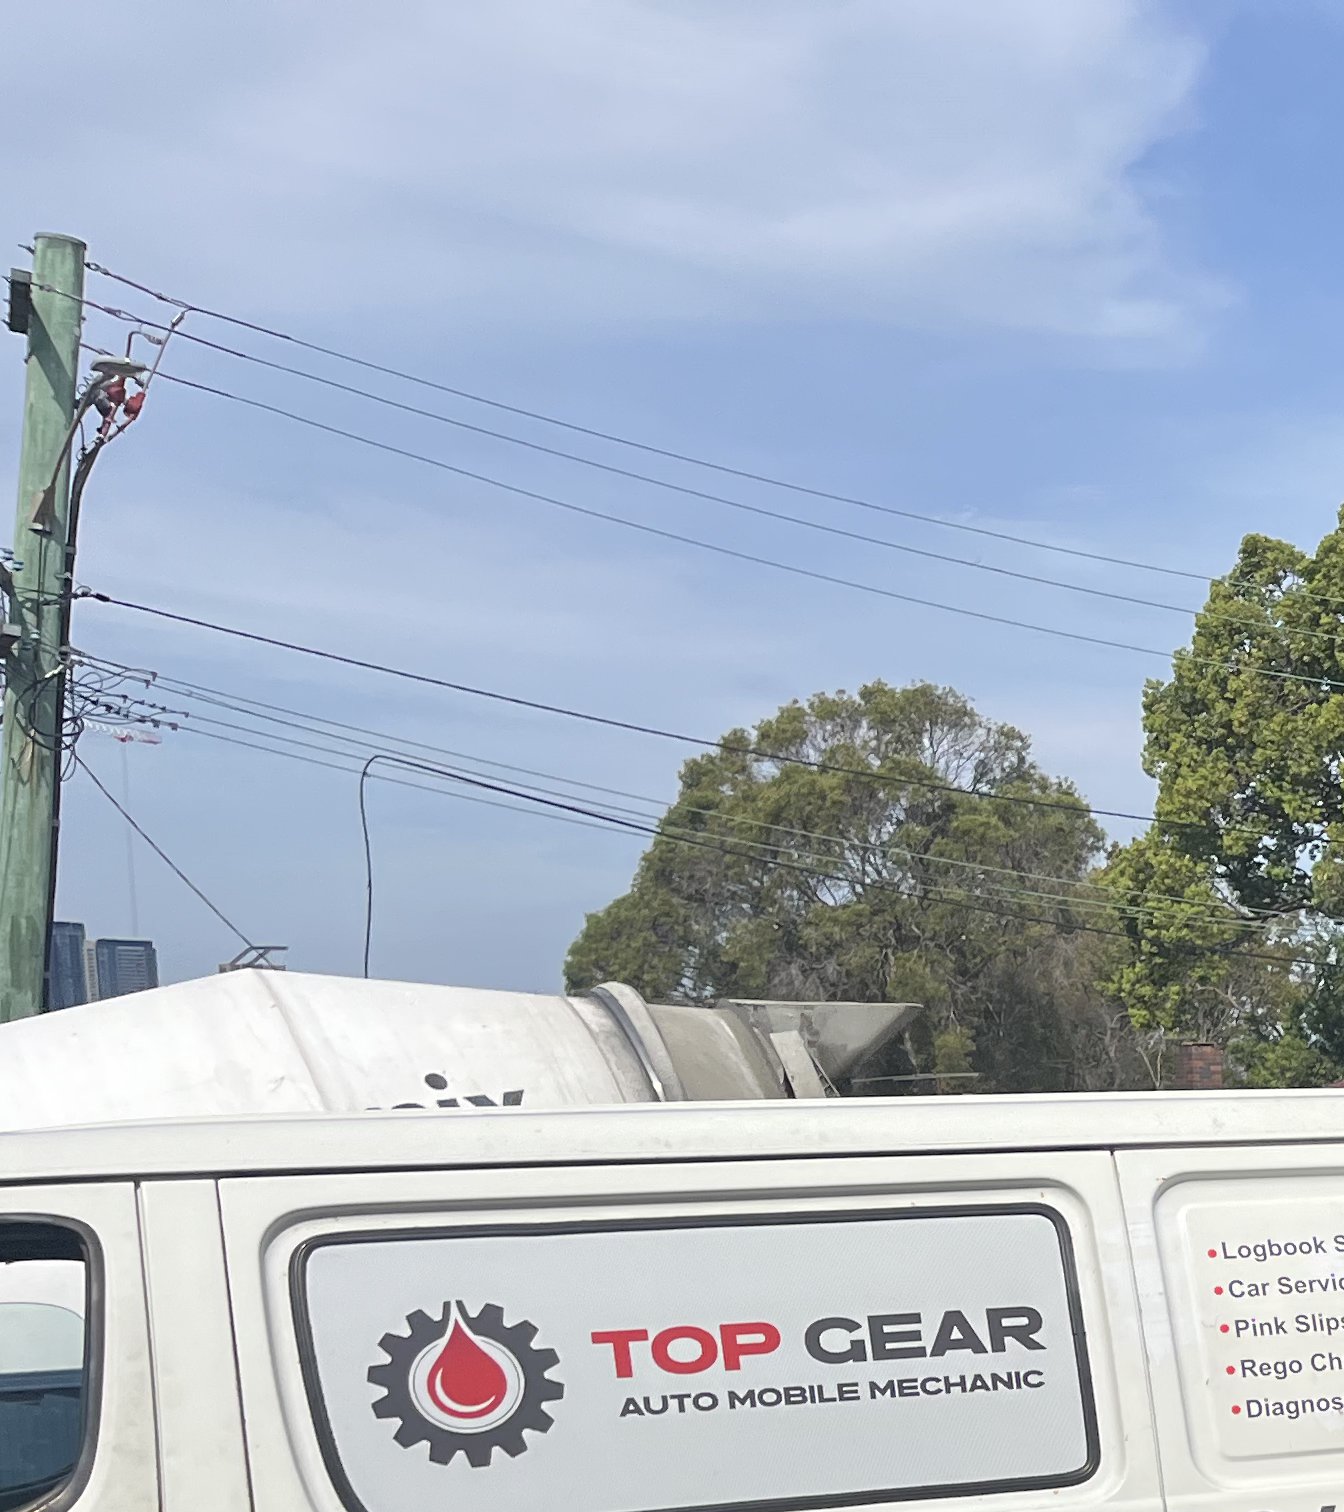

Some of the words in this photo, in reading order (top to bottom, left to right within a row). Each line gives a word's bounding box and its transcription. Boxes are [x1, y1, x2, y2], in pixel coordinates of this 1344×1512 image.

[1221, 1236, 1327, 1263] Logbook
[1228, 1279, 1270, 1299] Car
[1235, 1316, 1288, 1338] Pink
[590, 1321, 782, 1379] TOP
[804, 1306, 1048, 1365] GEAR
[1240, 1357, 1303, 1380] Rego
[619, 1391, 719, 1418] AUTO
[727, 1381, 861, 1410] MOBILE
[868, 1369, 1046, 1400] MECHANIC
